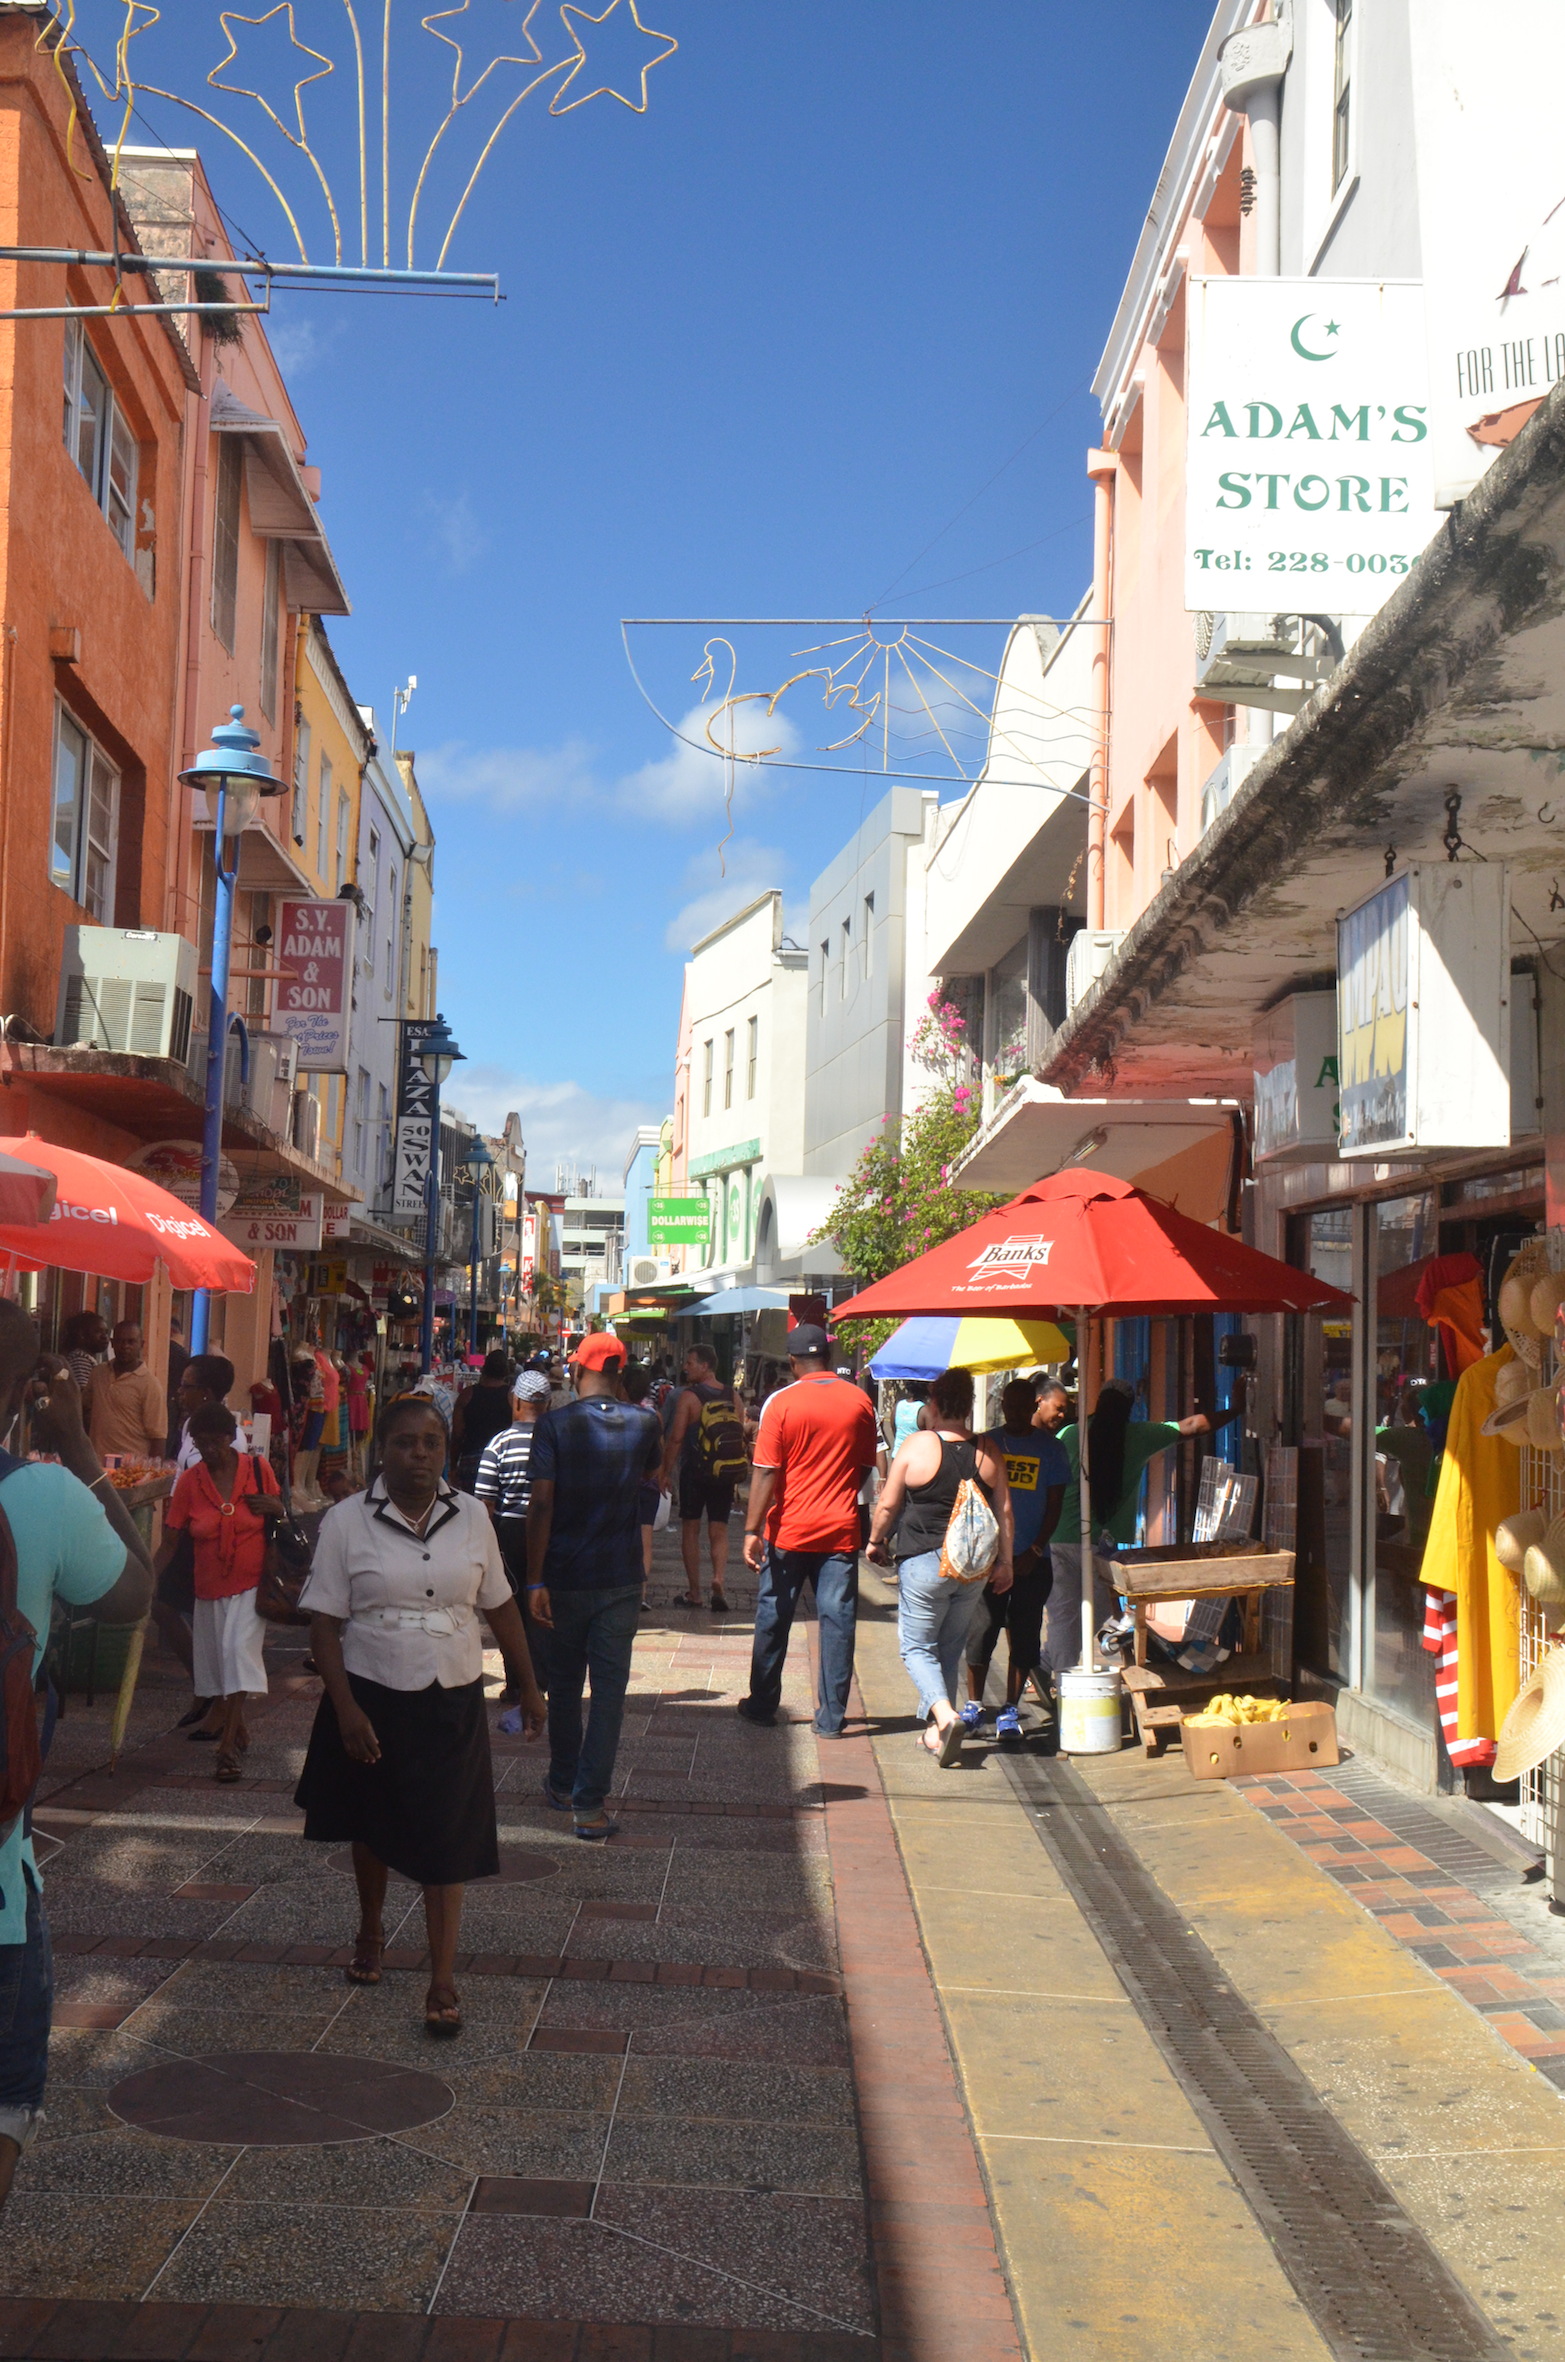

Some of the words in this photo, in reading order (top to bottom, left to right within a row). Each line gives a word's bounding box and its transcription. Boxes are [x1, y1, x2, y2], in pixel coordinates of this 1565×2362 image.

[1457, 347, 1494, 399] FOR
[1500, 338, 1537, 389] THE
[1199, 400, 1428, 443] ADAM'S
[1215, 472, 1410, 513] STORE
[1193, 549, 1252, 571] Tel:
[295, 908, 332, 932] S.Y.
[283, 934, 342, 959] ADAM
[303, 961, 320, 983] &
[288, 985, 332, 1010] SON
[285, 1016, 307, 1031] For
[308, 1014, 329, 1028] The
[406, 1026, 431, 1037] ESA
[402, 1125, 430, 1137] 50
[401, 1138, 429, 1197] SWAN
[50, 1200, 119, 1225] gicel
[395, 1199, 424, 1208] STREE
[145, 1212, 212, 1240] Digicel
[247, 1222, 260, 1240] &
[264, 1222, 298, 1241] SON
[981, 1245, 1047, 1264] Banks
[966, 1284, 983, 1292] Beer
[985, 1284, 996, 1292] of
[995, 1282, 1033, 1291] Barbados
[1006, 1460, 1039, 1474] EST
[1007, 1471, 1034, 1484] UD
